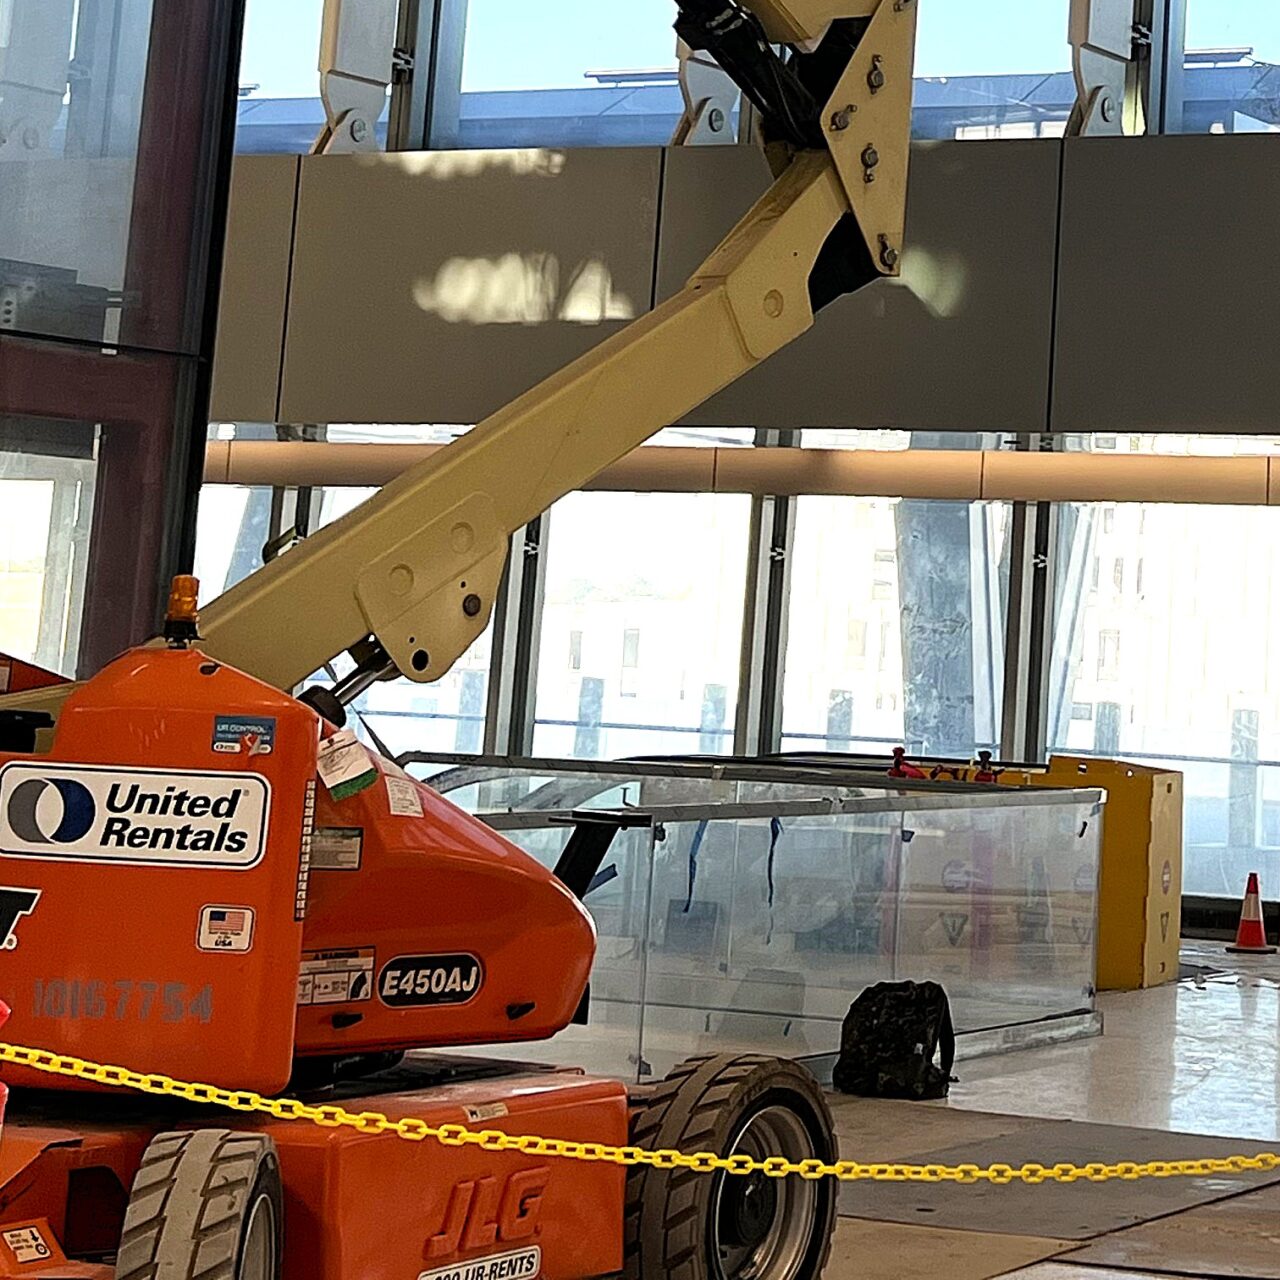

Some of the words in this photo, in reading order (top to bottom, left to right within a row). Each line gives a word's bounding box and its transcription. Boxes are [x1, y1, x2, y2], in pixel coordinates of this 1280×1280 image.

[106, 784, 242, 818] United
[100, 817, 248, 852] Rentals
[214, 939, 233, 947] USA
[382, 966, 478, 996] E450AJ
[33, 977, 214, 1024] 10167754
[423, 1165, 551, 1260] JLG
